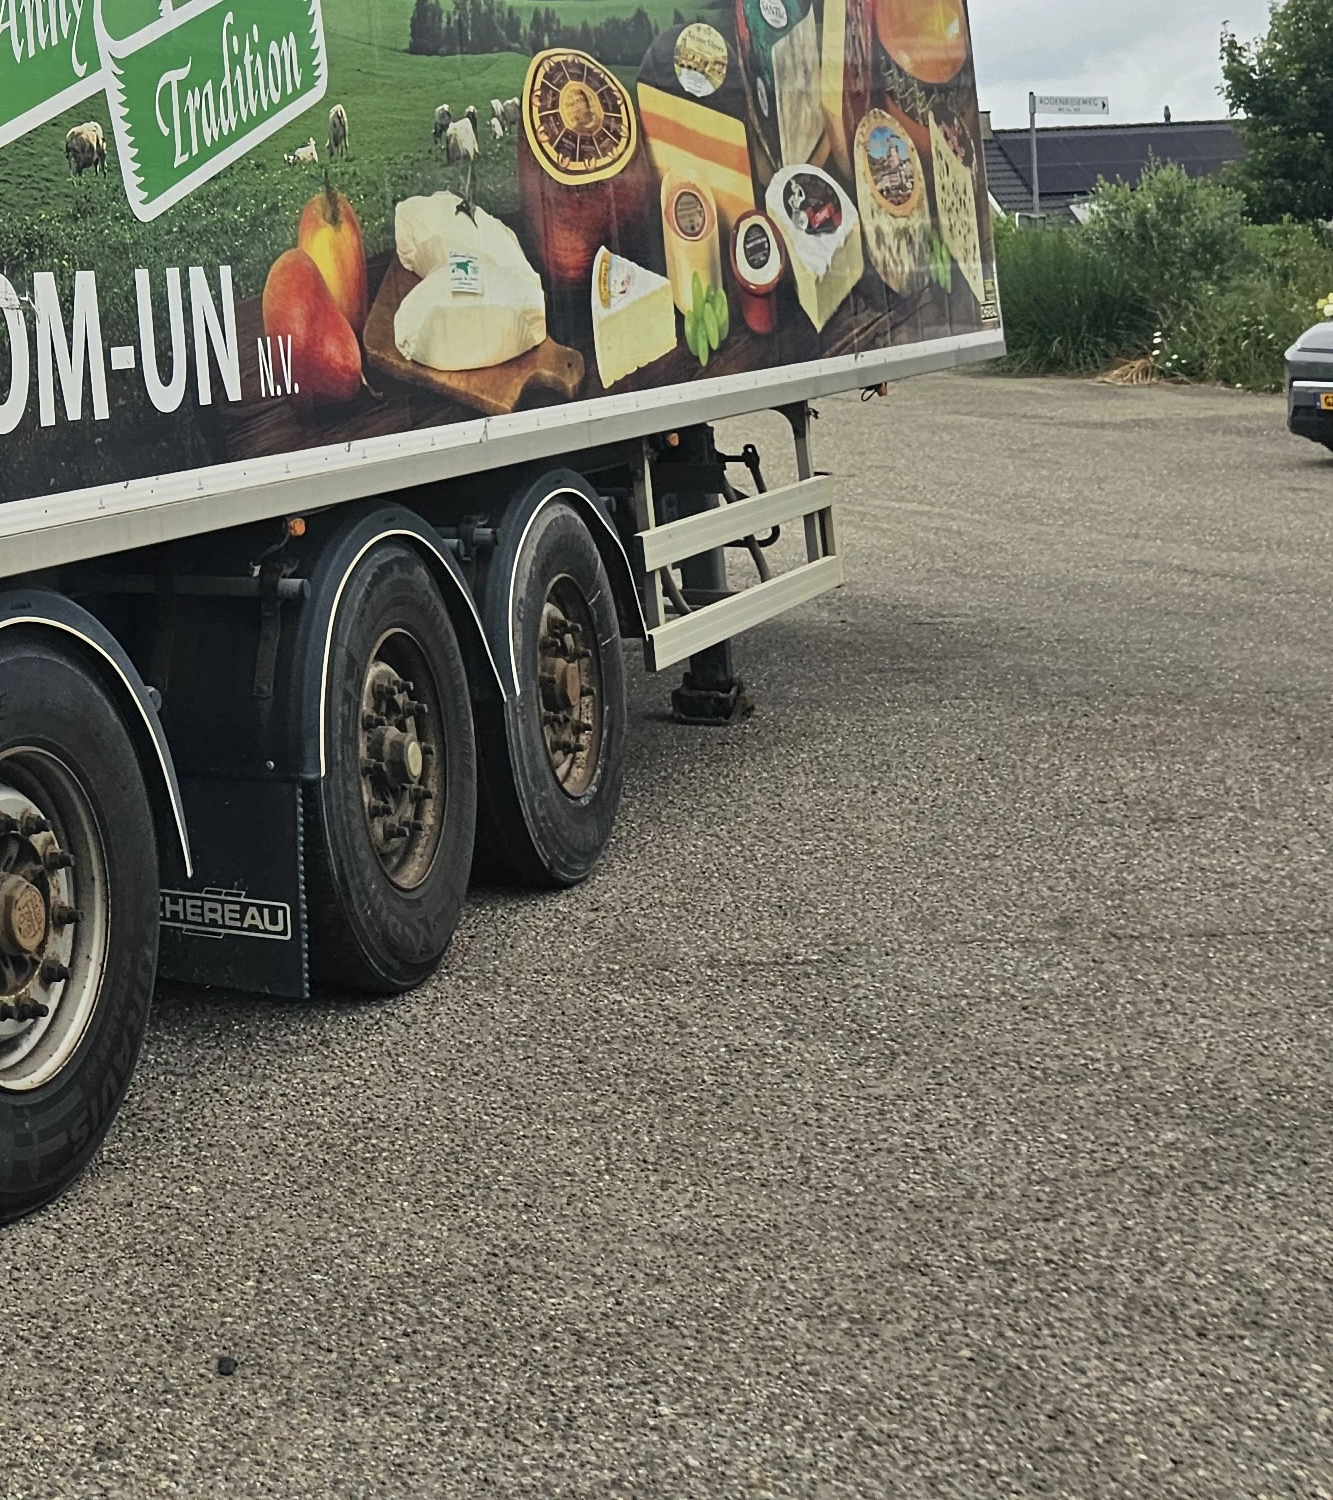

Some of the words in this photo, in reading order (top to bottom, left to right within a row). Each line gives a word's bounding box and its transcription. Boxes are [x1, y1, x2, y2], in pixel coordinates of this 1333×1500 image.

[155, 11, 303, 168] Tradition
[257, 335, 299, 398] N.V.
[160, 896, 284, 932] HEREAU
